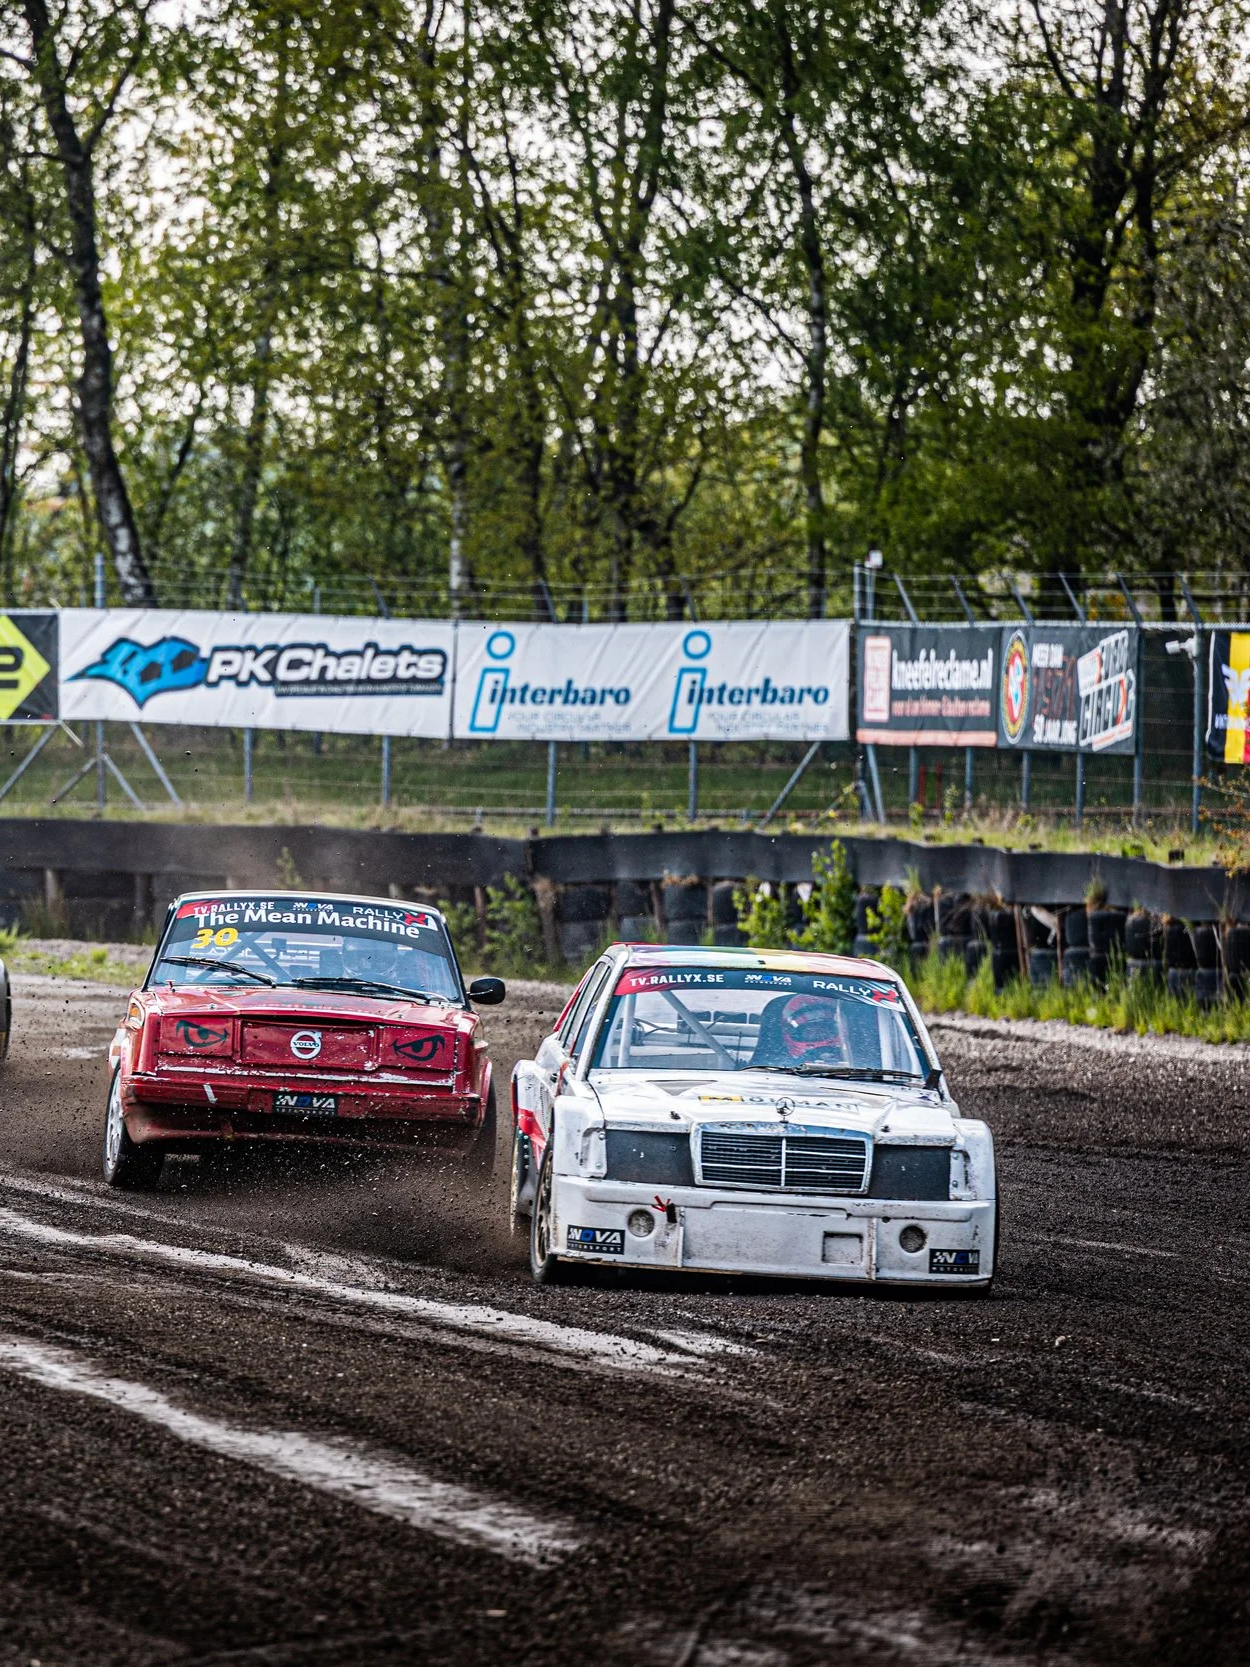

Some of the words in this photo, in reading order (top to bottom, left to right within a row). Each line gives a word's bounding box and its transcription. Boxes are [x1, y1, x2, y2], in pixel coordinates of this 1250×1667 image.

[206, 650, 277, 682] PK
[276, 648, 443, 682] Chalets
[489, 679, 630, 707] interbaro
[688, 678, 830, 707] interbaro
[194, 902, 274, 914] TV.RALLYX.SE
[195, 912, 240, 928] The
[244, 909, 311, 925] Mean
[317, 911, 420, 938] Machine
[192, 927, 239, 948] 30
[630, 974, 724, 987] TV.RALLYX.SE
[275, 1095, 335, 1109] NOVA
[568, 1228, 622, 1244] NOVA
